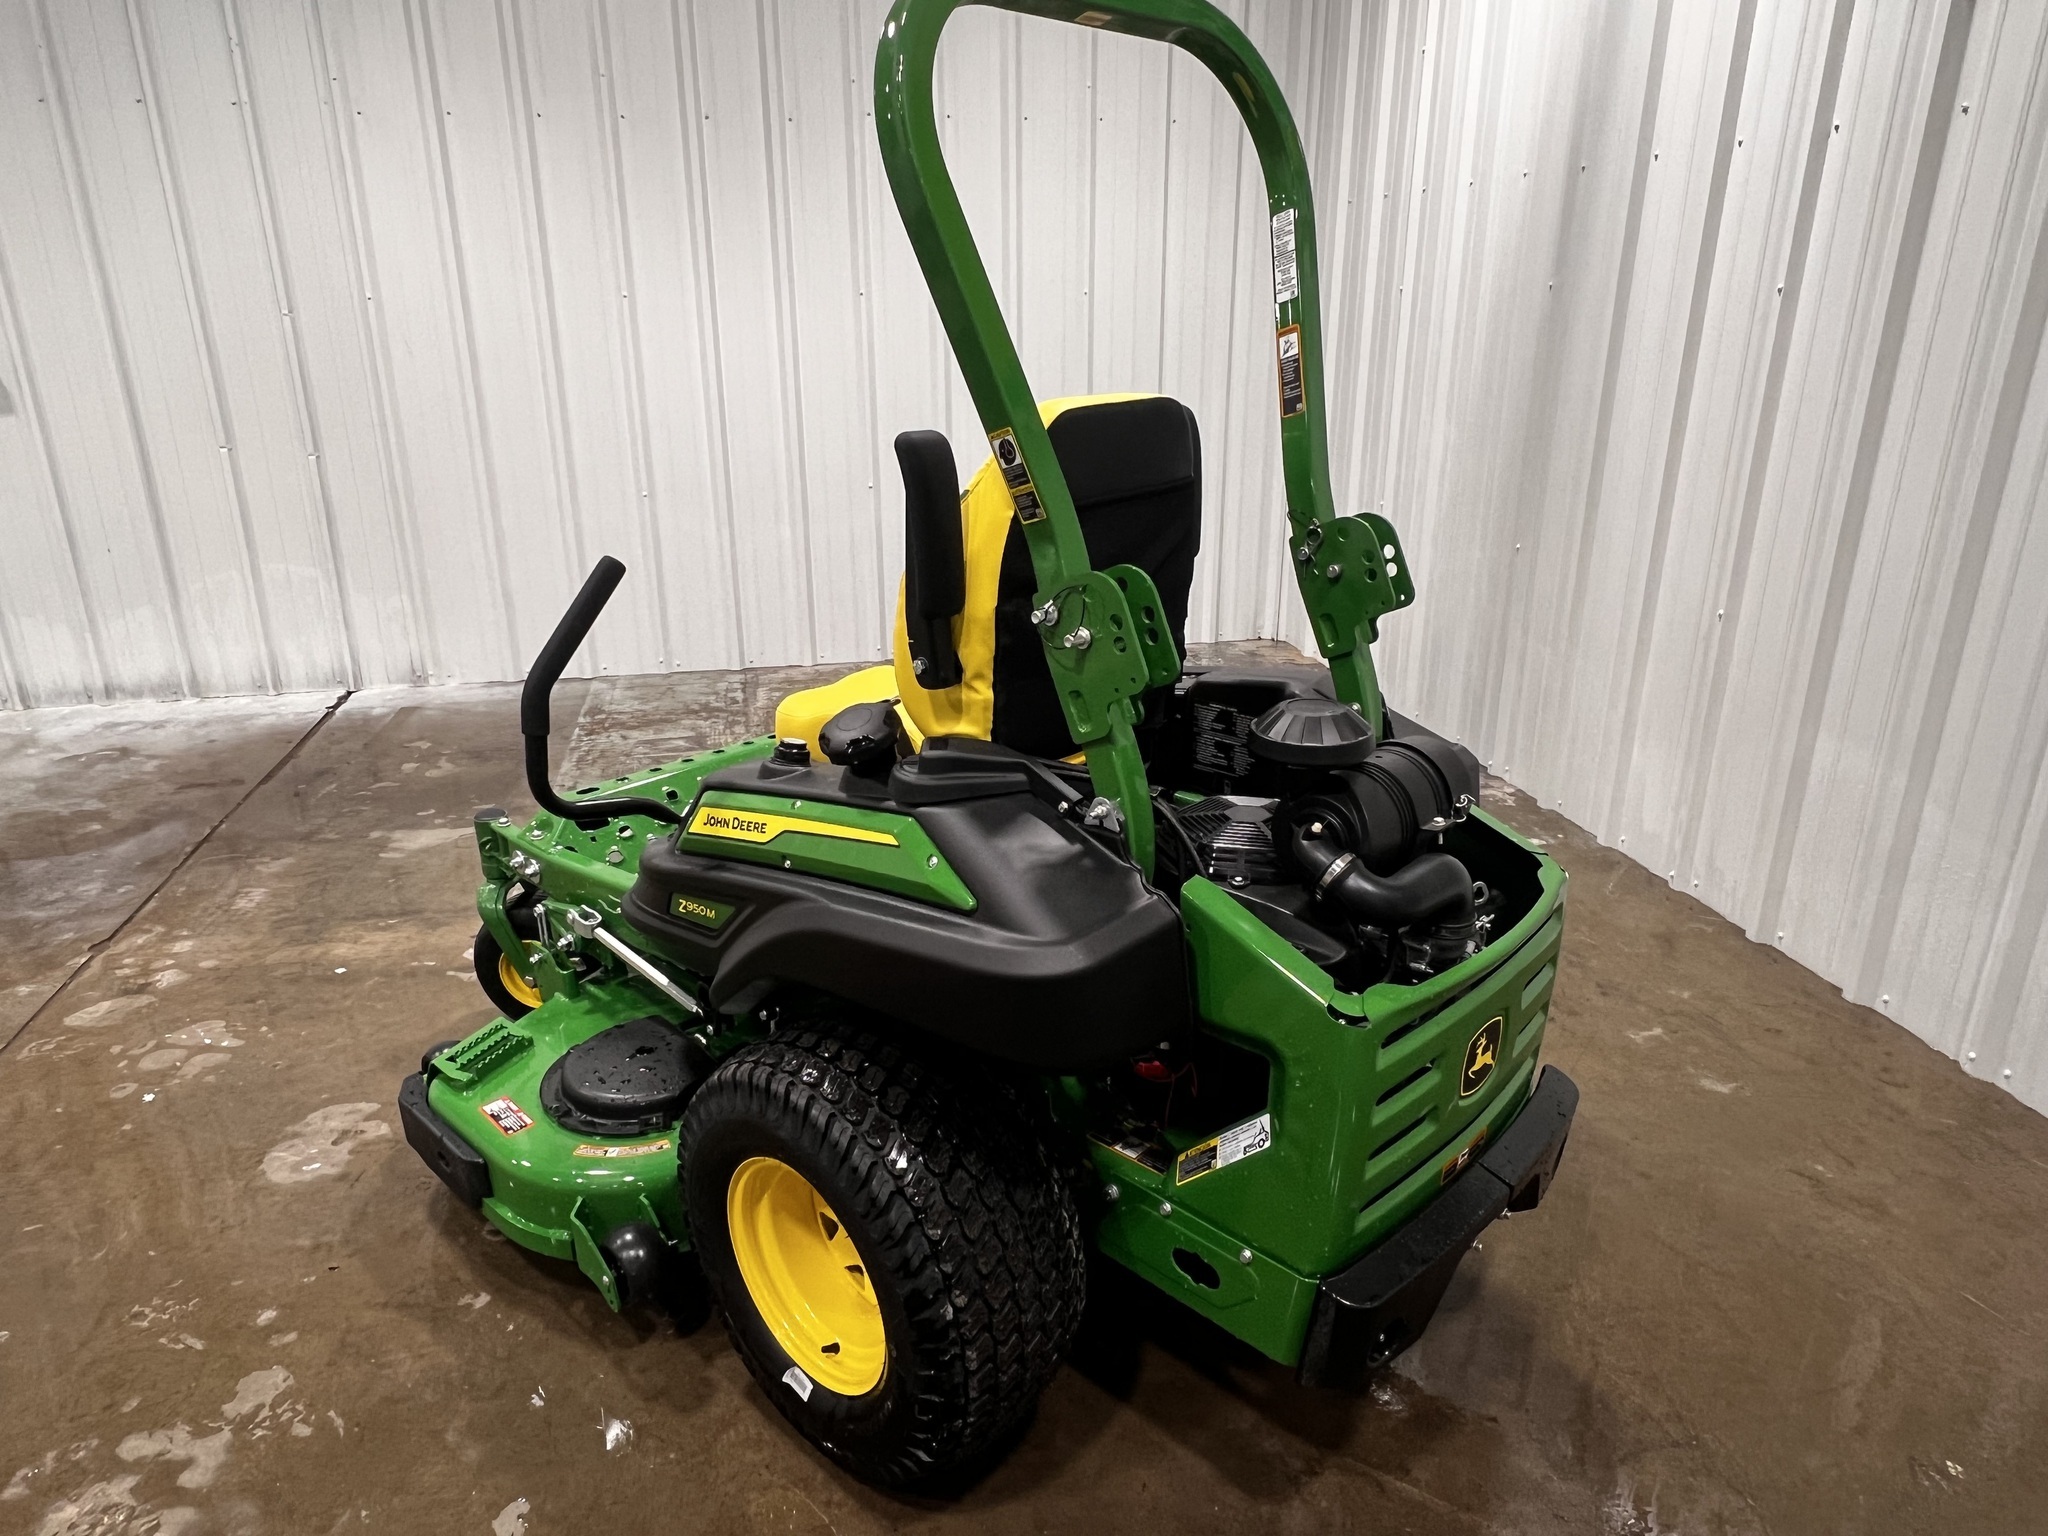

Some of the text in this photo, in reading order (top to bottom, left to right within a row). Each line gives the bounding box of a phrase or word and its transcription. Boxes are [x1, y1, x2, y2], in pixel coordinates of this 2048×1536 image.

[703, 813, 767, 834] JOHN DEERE
[678, 899, 716, 920] Z950M
